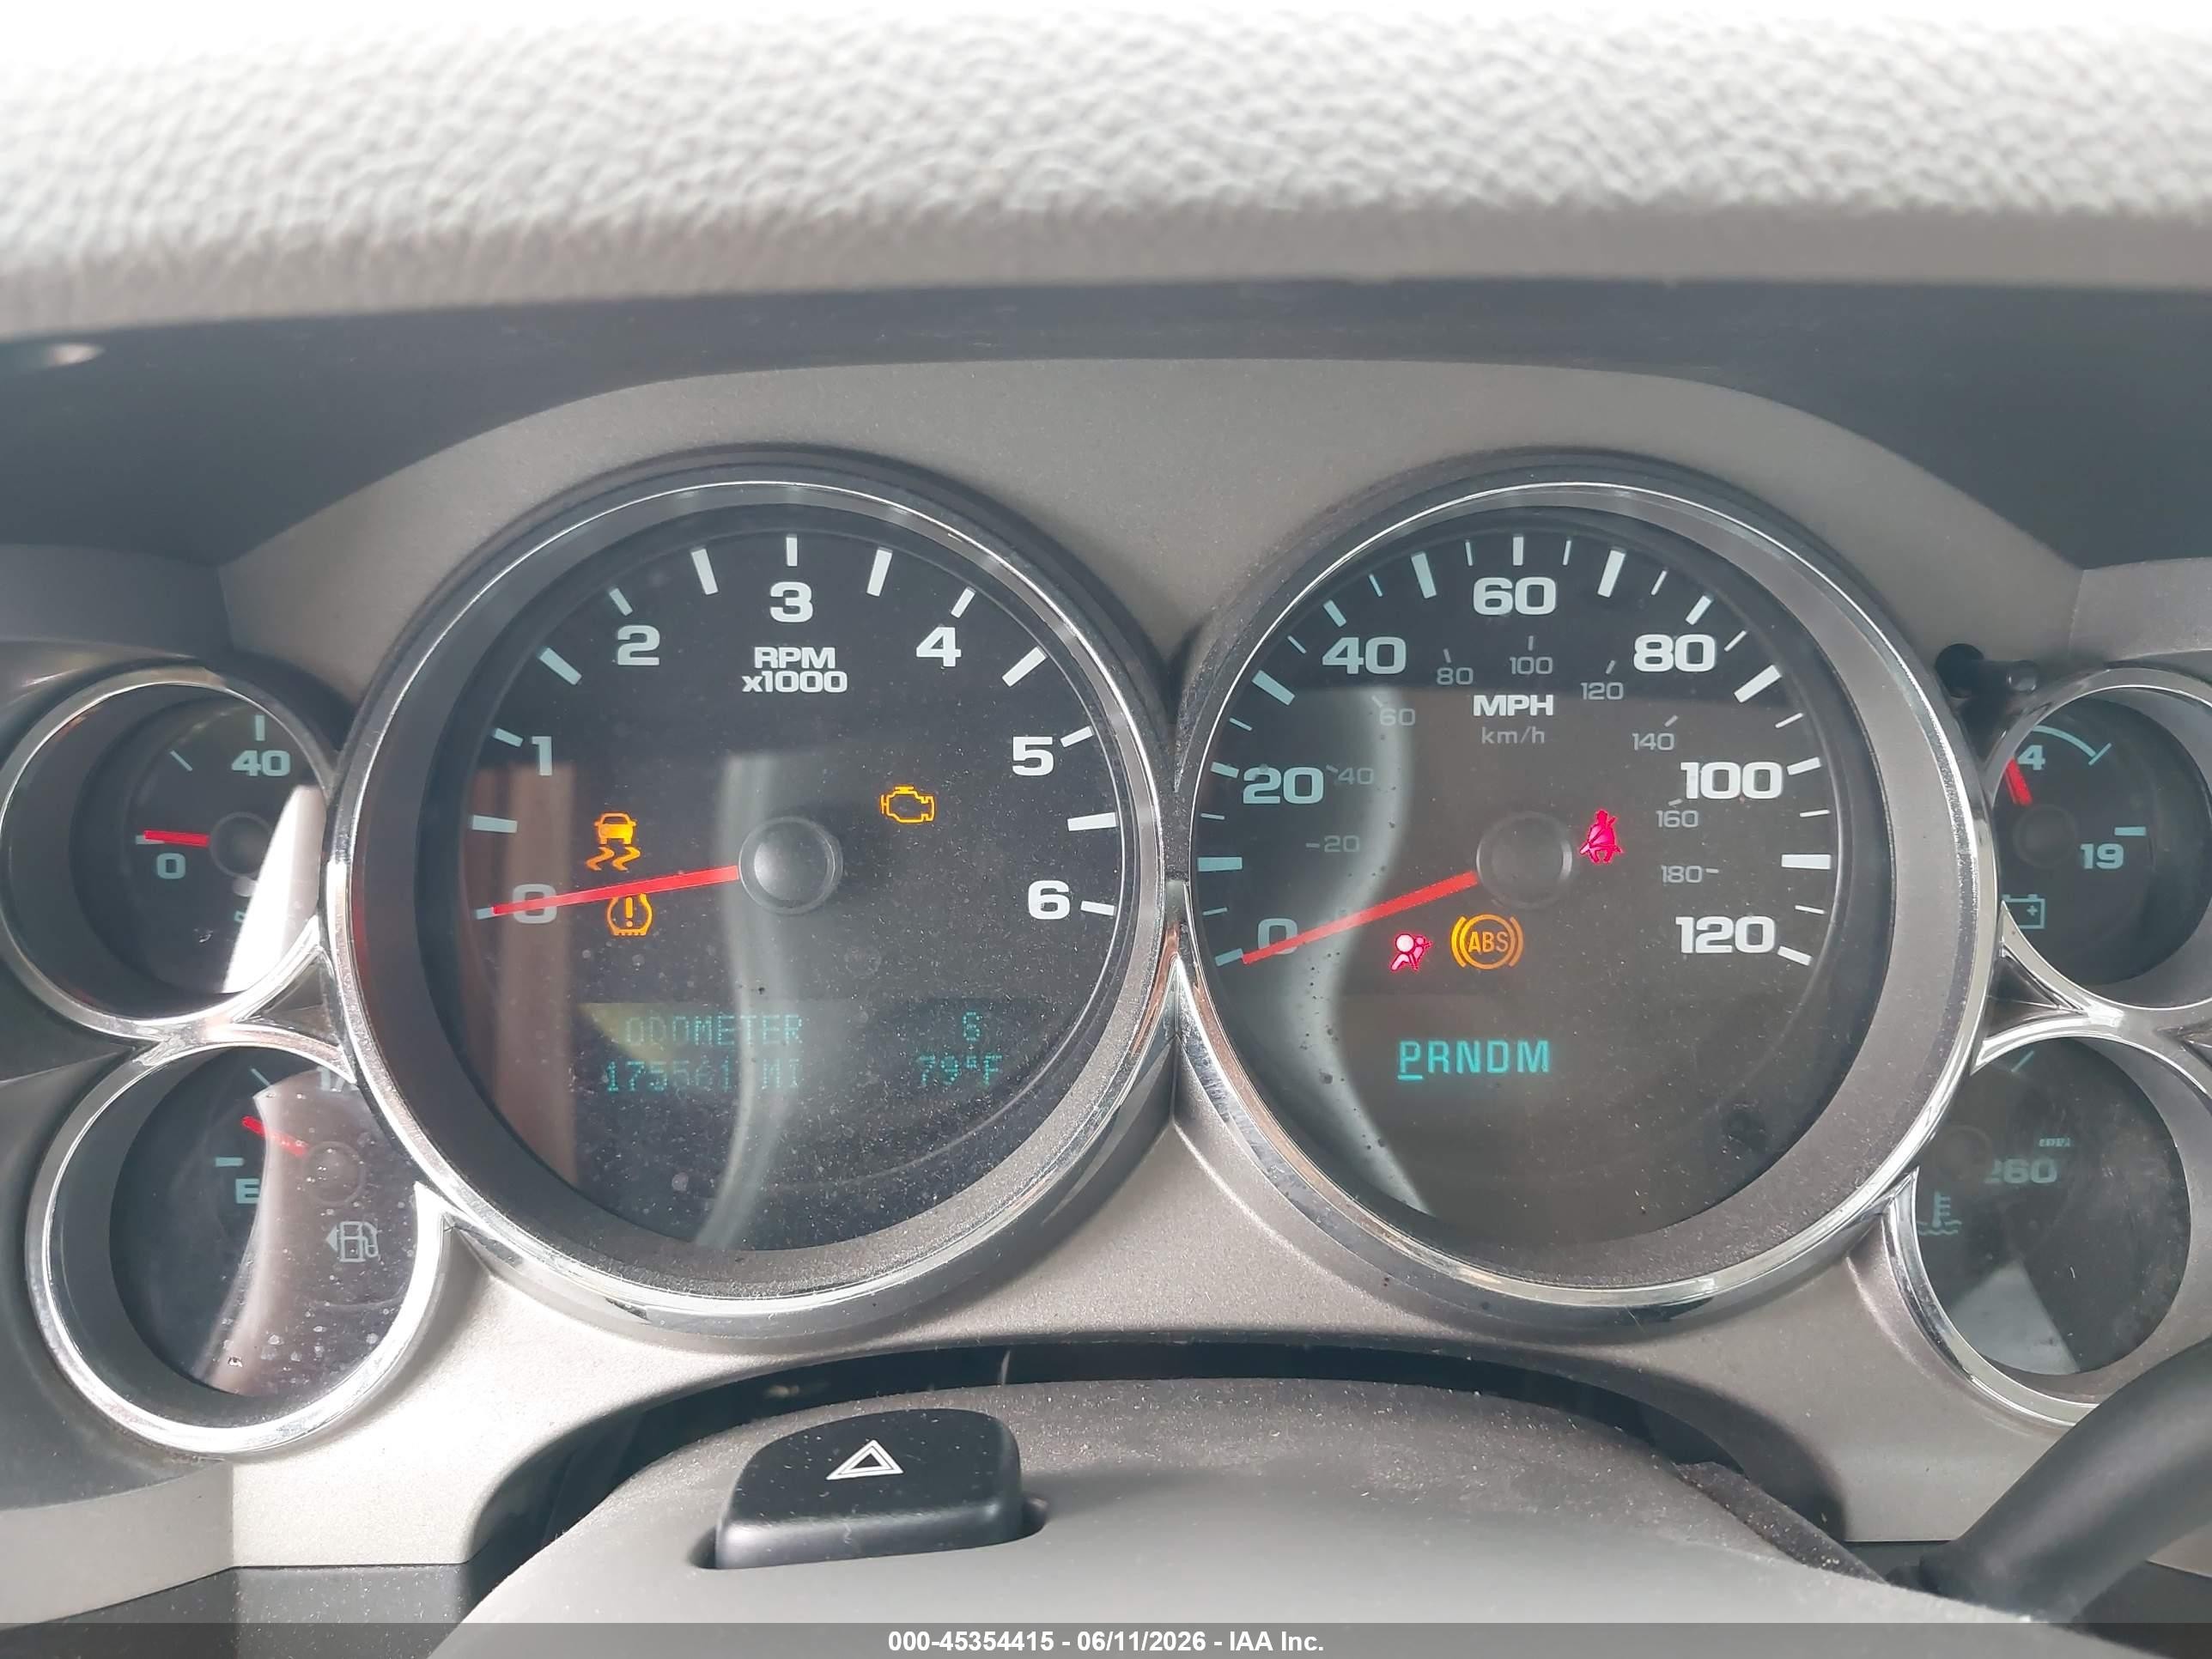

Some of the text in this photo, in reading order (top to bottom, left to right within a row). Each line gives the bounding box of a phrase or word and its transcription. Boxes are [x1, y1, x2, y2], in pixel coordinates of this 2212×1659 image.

[769, 582, 813, 623] 3
[1473, 577, 1557, 616] 60
[617, 625, 660, 666] 2
[753, 647, 836, 670] RPM
[916, 627, 962, 667] 4
[1322, 636, 1407, 674] 40
[1633, 634, 1716, 672] 80
[1436, 666, 1474, 686] 80
[1509, 656, 1553, 676] 100
[742, 671, 848, 694] x1000
[1581, 682, 1624, 702] 120
[1379, 708, 1416, 726] 60
[1473, 695, 1553, 717] MPH
[1480, 726, 1546, 745] km/h
[1632, 732, 1674, 751] 140
[231, 750, 291, 776] 40
[531, 736, 553, 776] 1
[1012, 737, 1055, 776] 5
[1243, 766, 1324, 805] 20
[1336, 767, 1375, 786] 40
[1680, 762, 1783, 799] 100
[1656, 810, 1699, 829] 160
[1323, 835, 1360, 853] 20
[2080, 842, 2124, 870] 19
[156, 853, 186, 880] 0
[1661, 865, 1703, 884] 180
[513, 884, 556, 925] 0
[1028, 880, 1071, 921] 6
[1257, 918, 1298, 955] 0
[1468, 929, 1510, 952] ABS
[1674, 915, 1776, 954] 120
[625, 1014, 804, 1045] ODOMETER
[962, 1011, 981, 1042] 6
[1399, 1040, 1551, 1074] PRNDM
[235, 1178, 260, 1204] E
